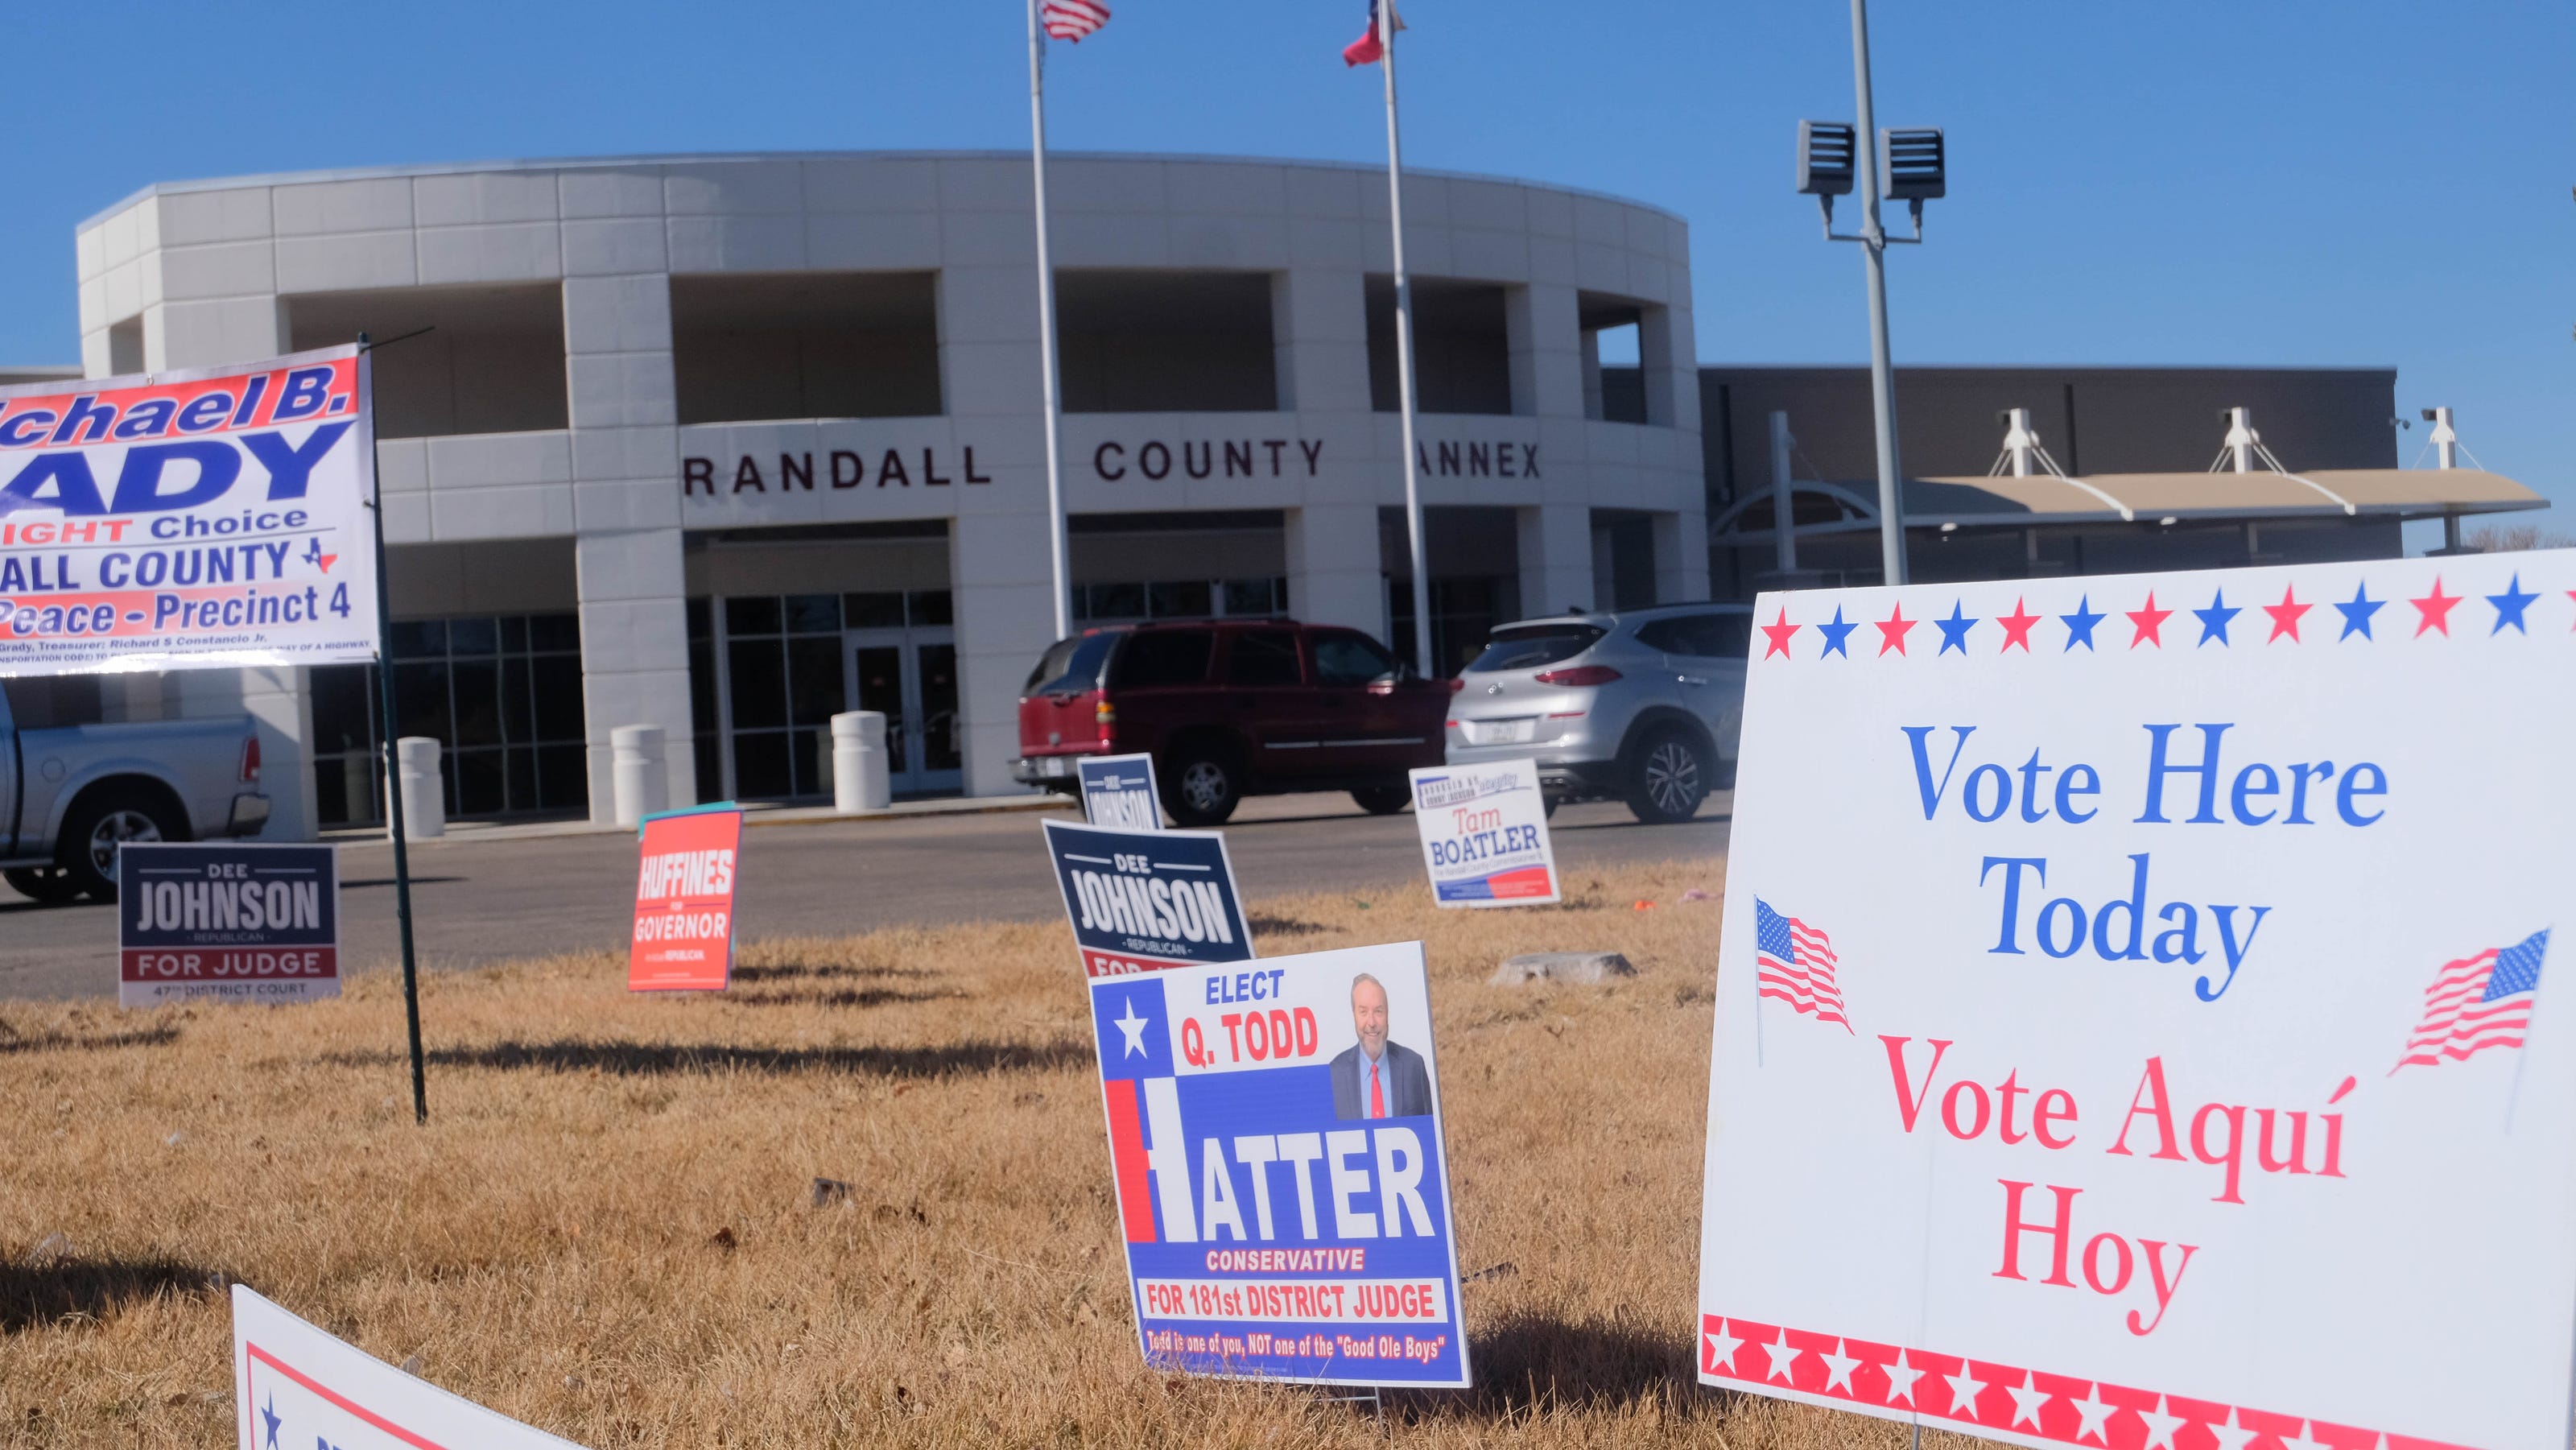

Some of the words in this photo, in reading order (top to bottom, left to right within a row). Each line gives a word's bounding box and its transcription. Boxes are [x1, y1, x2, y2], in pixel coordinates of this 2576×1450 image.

[0, 376, 269, 446] chael
[271, 368, 349, 419] B.
[0, 420, 357, 517] ADY
[683, 446, 991, 496] RANDALL
[1094, 440, 1322, 481] COUNTY
[3, 519, 133, 545] IGHT
[151, 510, 308, 539] Choice
[0, 556, 79, 593] ALL
[100, 541, 290, 588] COUNTY
[154, 586, 318, 630] Precinct
[329, 582, 350, 618] 4
[40, 641, 105, 651] Treasurer:
[110, 638, 159, 649] Richard
[177, 634, 249, 646] Constancio
[254, 634, 267, 642] Jr.
[1901, 725, 2101, 824] Vote
[2135, 724, 2387, 828] Here
[1452, 808, 1501, 834] Tam
[1114, 853, 1151, 874] DEE
[1430, 824, 1540, 865] BOATLER
[208, 864, 247, 878] DEE
[638, 849, 733, 900] HUFFINES
[137, 881, 320, 932] JOHNSON
[635, 912, 727, 943] GOVERNOR
[1071, 869, 1233, 944] JOHNSON
[1979, 853, 2271, 1002] Today
[194, 932, 264, 942] REPUBLICAN
[138, 953, 200, 976] FOR
[213, 952, 320, 975] JUDGE
[186, 984, 252, 996] DISTRICT
[258, 983, 306, 994] COURT
[1205, 969, 1284, 1005] ELECT
[1181, 1017, 1215, 1069] Q.
[1221, 1006, 1318, 1063] TODD
[1877, 1034, 2079, 1150] Vote
[2107, 1056, 2356, 1204] Aquí
[1105, 1076, 1435, 1243] HATTER
[1206, 1249, 1364, 1271] CONSERVATIVE
[1992, 1179, 2198, 1336] Hoy
[1146, 1284, 1186, 1314] FOR
[1189, 1285, 1242, 1316] 181st
[1248, 1285, 1344, 1317] DISTRICT
[1353, 1284, 1435, 1318] JUDGE
[1187, 1336, 1206, 1352] one
[1209, 1332, 1219, 1353] of
[1222, 1337, 1245, 1360] you,
[1249, 1334, 1271, 1354] NOT
[1274, 1338, 1295, 1356] one
[1298, 1334, 1311, 1356] of
[1314, 1334, 1333, 1357] the
[1336, 1336, 1375, 1357] "Good
[1379, 1336, 1401, 1358] Ole
[1406, 1336, 1446, 1364] Boys"
